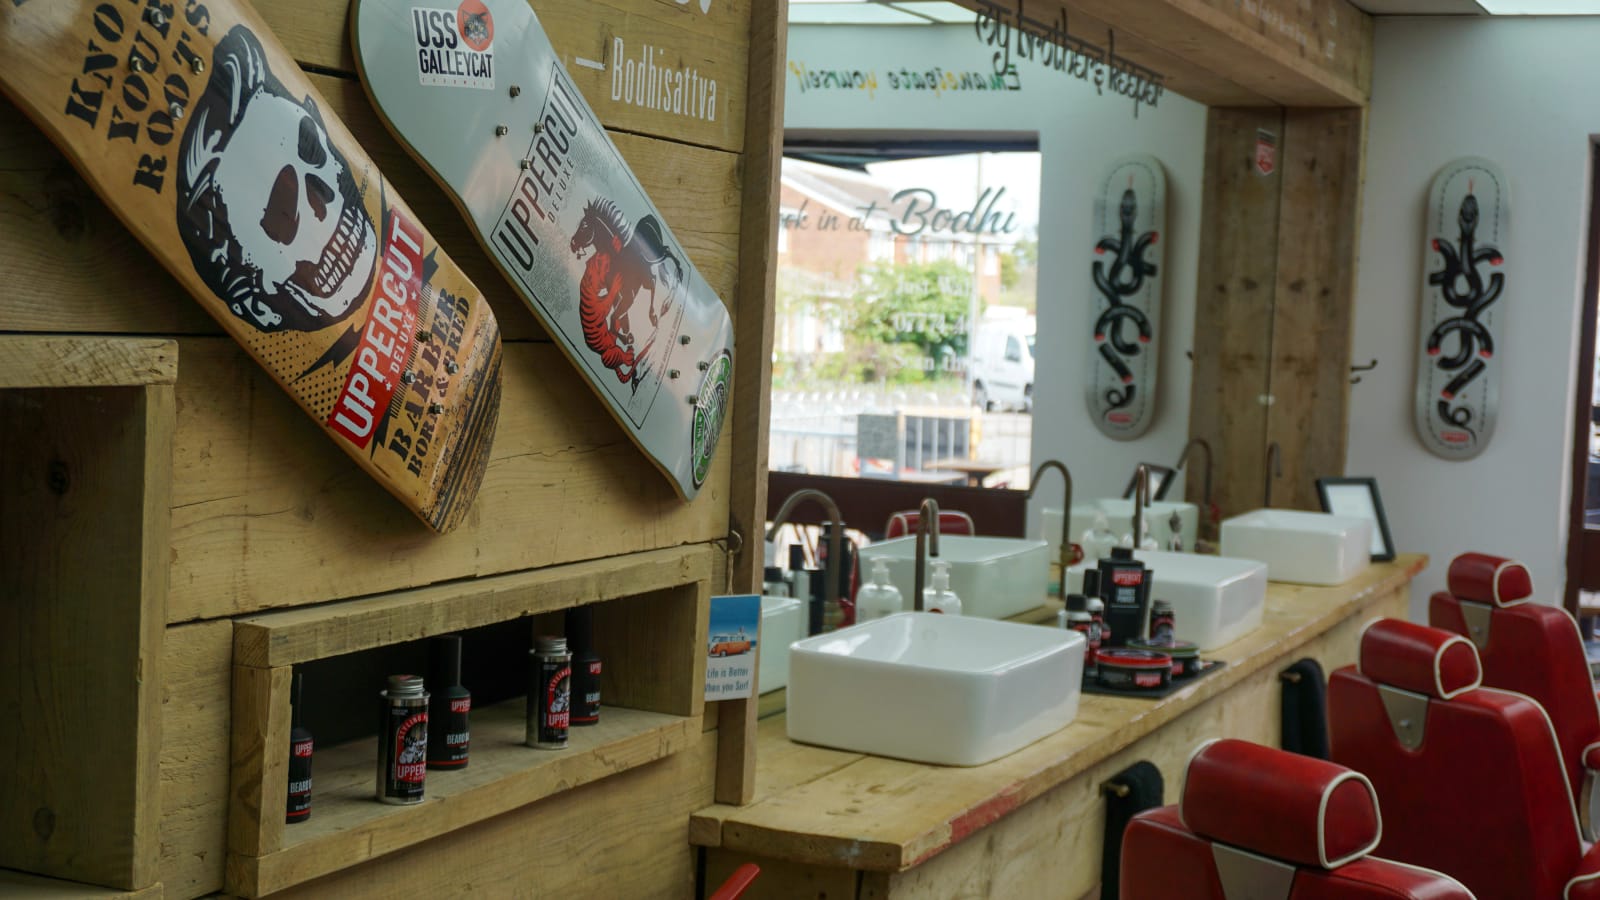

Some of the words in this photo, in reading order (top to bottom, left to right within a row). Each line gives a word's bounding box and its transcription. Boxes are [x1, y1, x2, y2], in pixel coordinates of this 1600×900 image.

[413, 10, 458, 49] USS
[65, 0, 139, 130] KNO
[419, 48, 493, 78] GALLEYCAT
[611, 36, 717, 121] Bodhisattva
[498, 73, 584, 272] UPPERCUT
[547, 156, 575, 224] DELUXE
[817, 209, 842, 231] in
[889, 185, 1019, 236] Bodhi
[335, 216, 421, 438] UPPERCUT
[390, 310, 416, 375] DELUXE
[388, 287, 456, 463] BARBER
[707, 668, 719, 680] Life
[728, 667, 749, 677] Better
[722, 684, 734, 694] you
[735, 680, 749, 691] Surf
